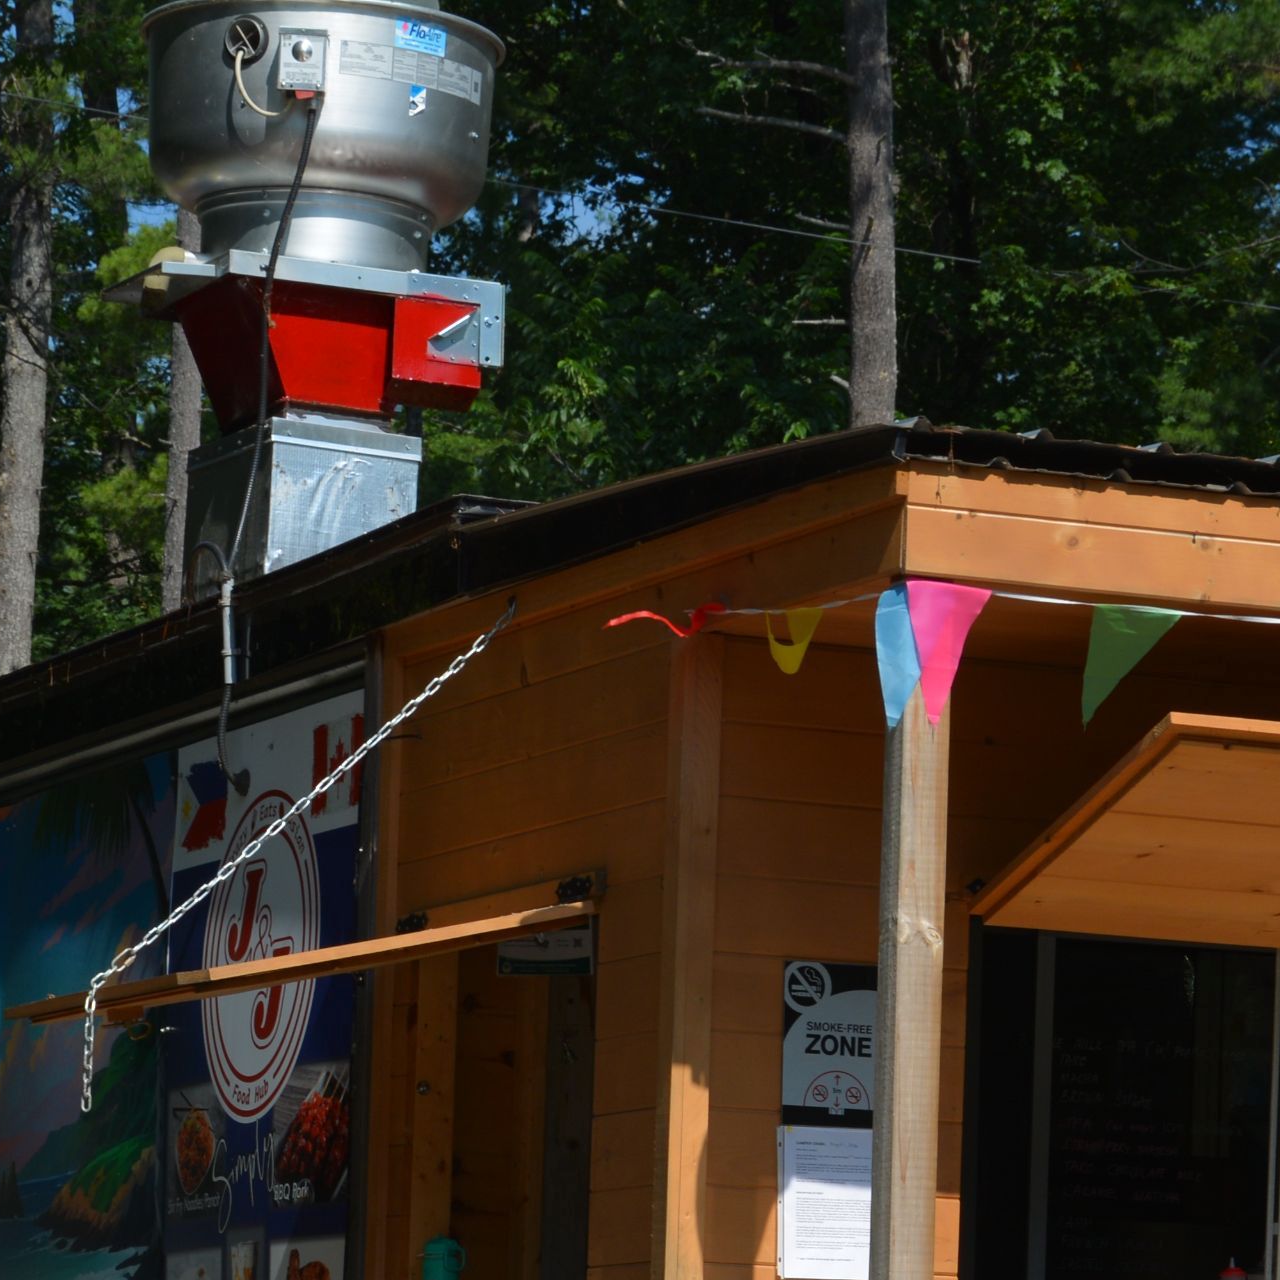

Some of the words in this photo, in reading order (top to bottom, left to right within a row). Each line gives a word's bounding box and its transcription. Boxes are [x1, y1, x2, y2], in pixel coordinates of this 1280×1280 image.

[260, 804, 277, 820] Eats
[228, 868, 264, 962] J
[806, 1021, 873, 1035] SMOKE-FREE
[805, 1033, 873, 1058] ZONE
[233, 1084, 251, 1105] Food
[254, 1080, 269, 1104] Hub
